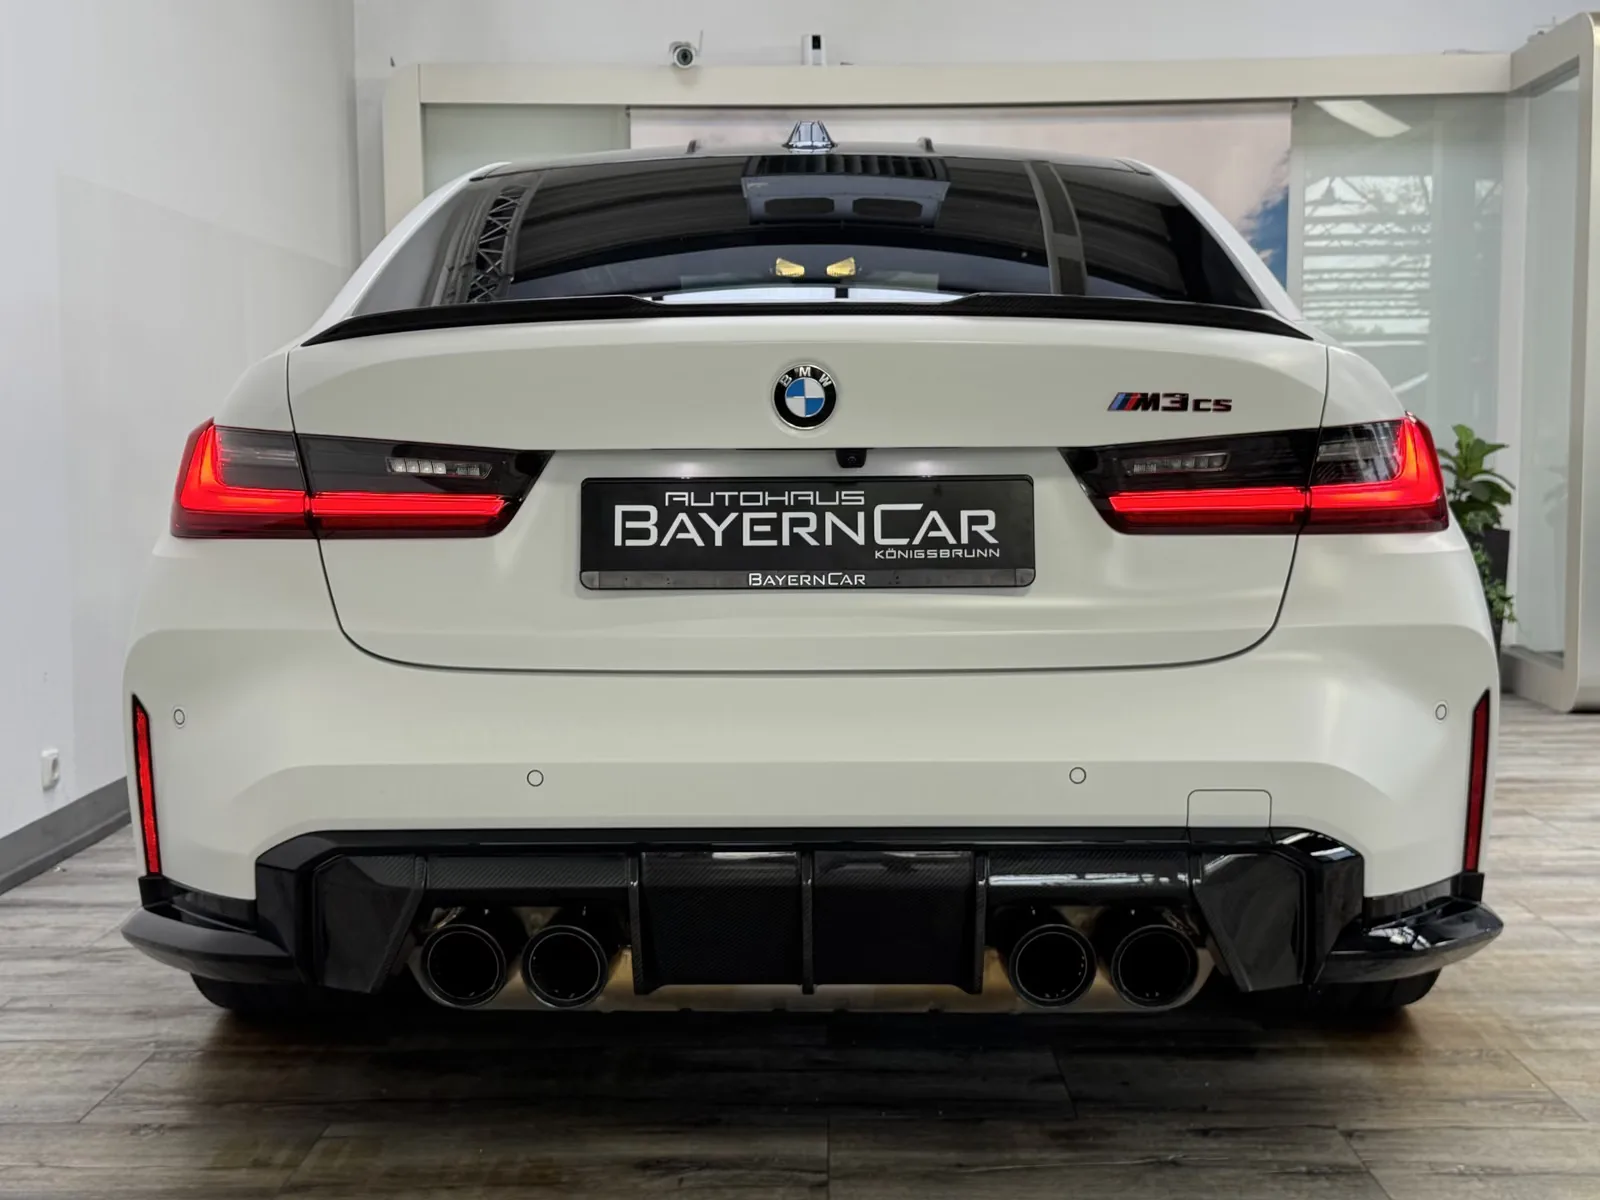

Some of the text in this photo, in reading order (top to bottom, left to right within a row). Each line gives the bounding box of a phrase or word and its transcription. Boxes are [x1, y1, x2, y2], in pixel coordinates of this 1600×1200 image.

[779, 366, 832, 388] BMW
[665, 490, 865, 506] AUTOHAUS
[874, 547, 1000, 560] KÖNIGSBRUNN
